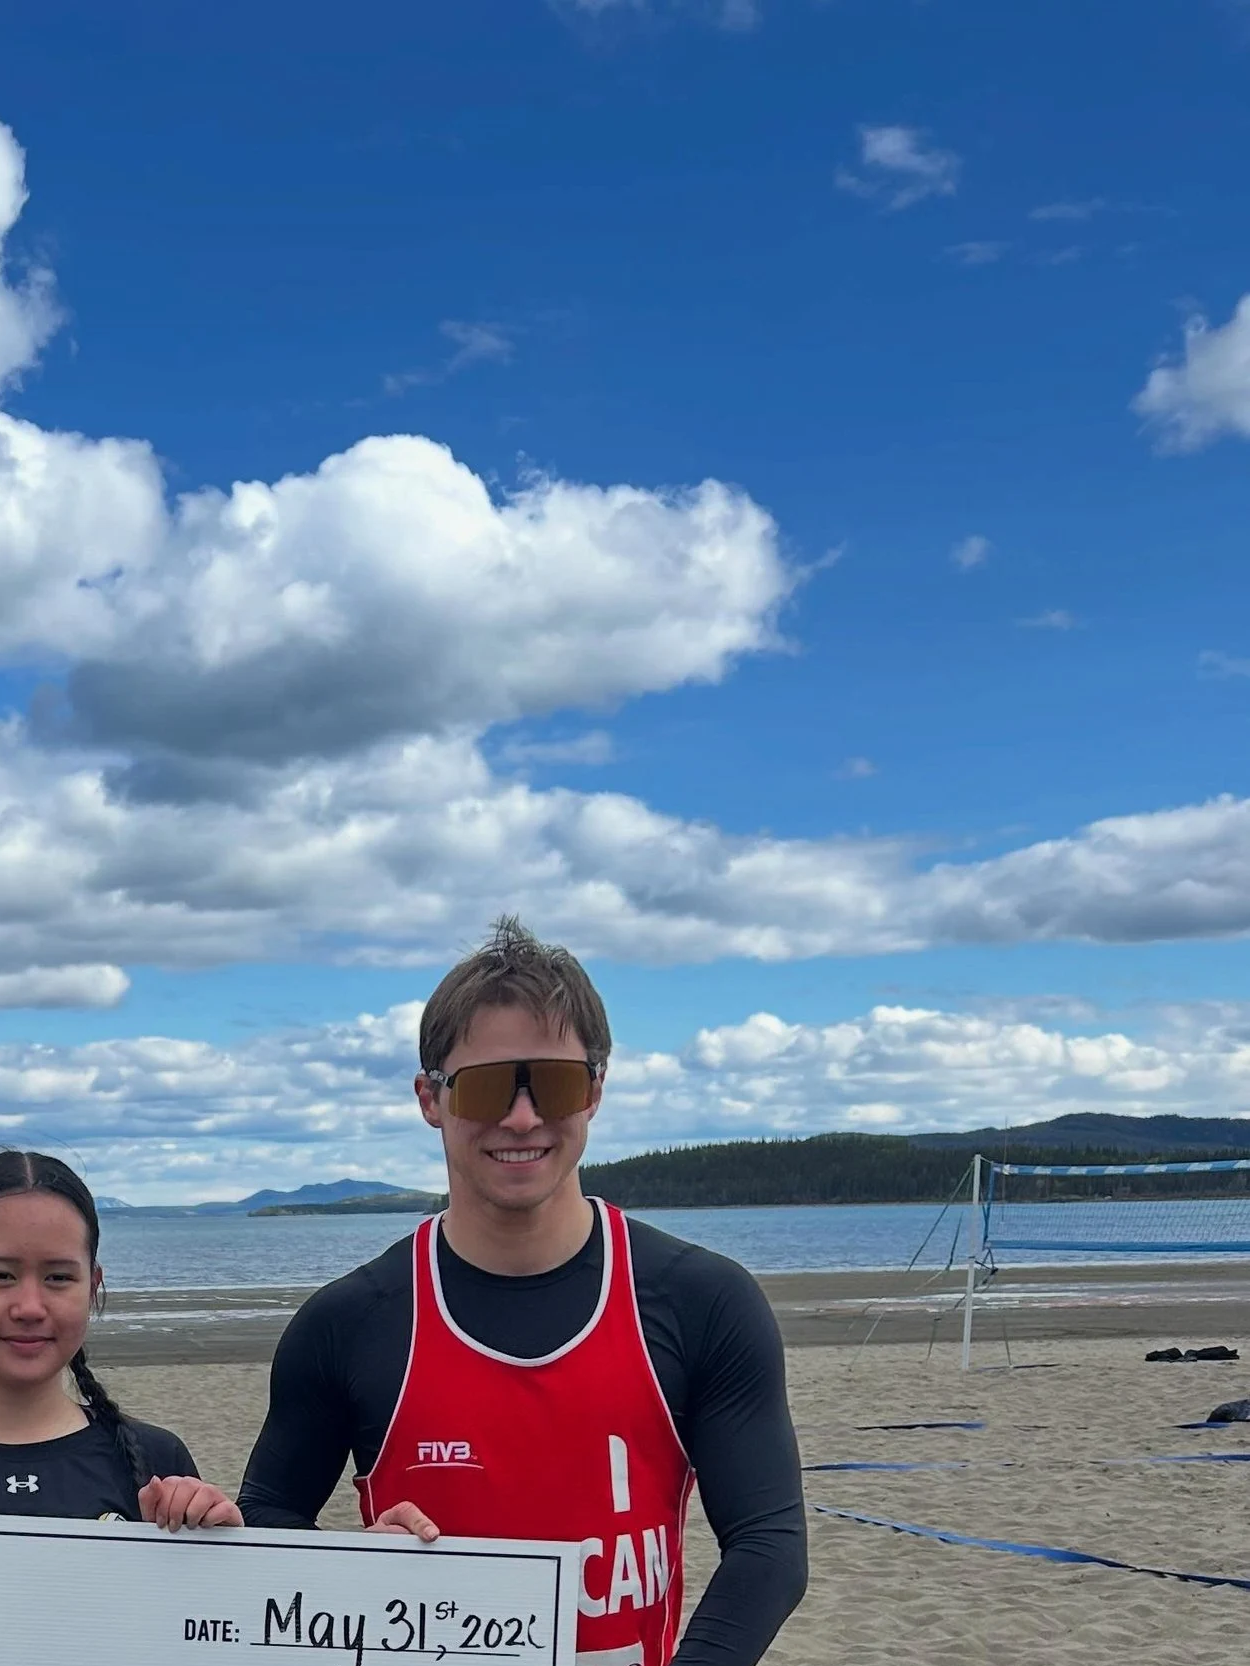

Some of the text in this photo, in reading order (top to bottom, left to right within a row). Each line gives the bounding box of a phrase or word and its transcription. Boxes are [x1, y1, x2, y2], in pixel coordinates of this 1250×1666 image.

[417, 1441, 471, 1462] FIVB
[578, 1525, 669, 1618] CAN
[184, 1618, 240, 1643] DATE:
